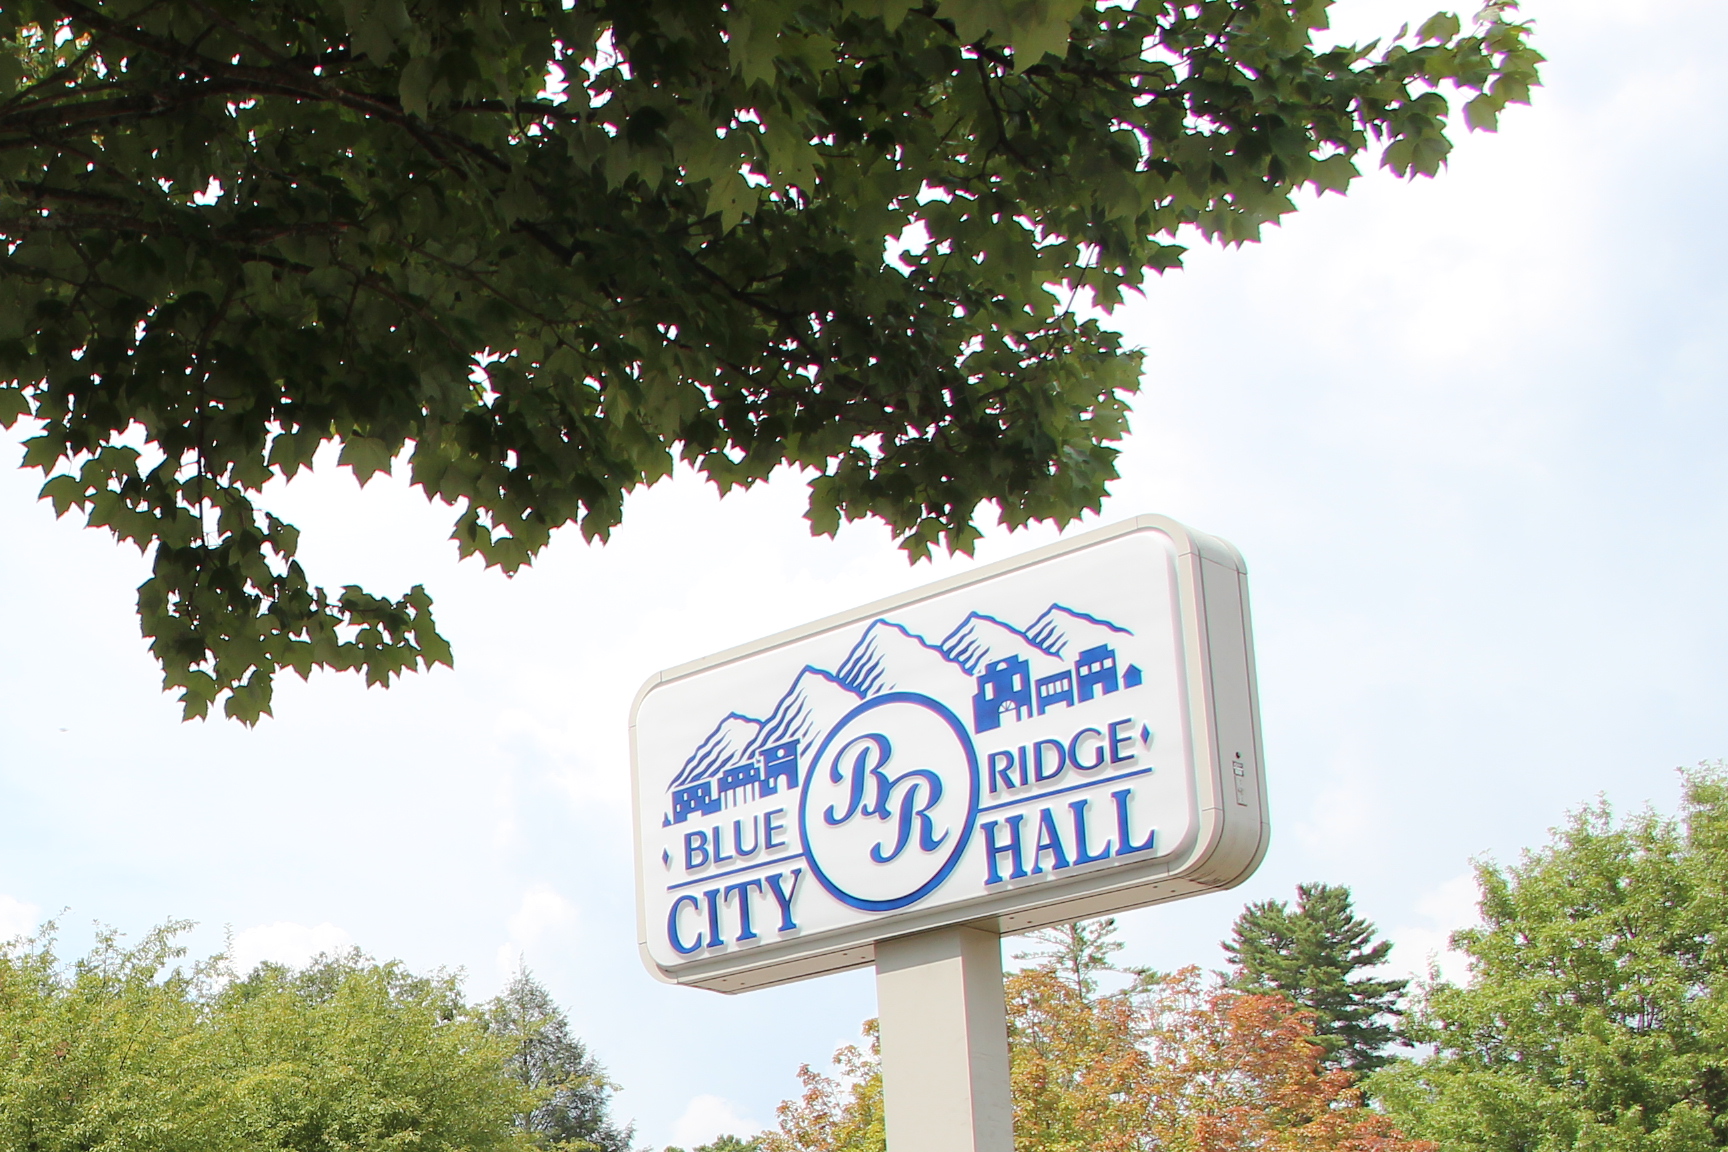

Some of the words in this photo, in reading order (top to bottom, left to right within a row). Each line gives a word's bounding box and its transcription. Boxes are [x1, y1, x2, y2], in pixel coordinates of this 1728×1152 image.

[666, 867, 803, 956] CITY
[980, 788, 1157, 886] HALL
[683, 807, 788, 870] BLUE
[987, 717, 1137, 794] RIDGE
